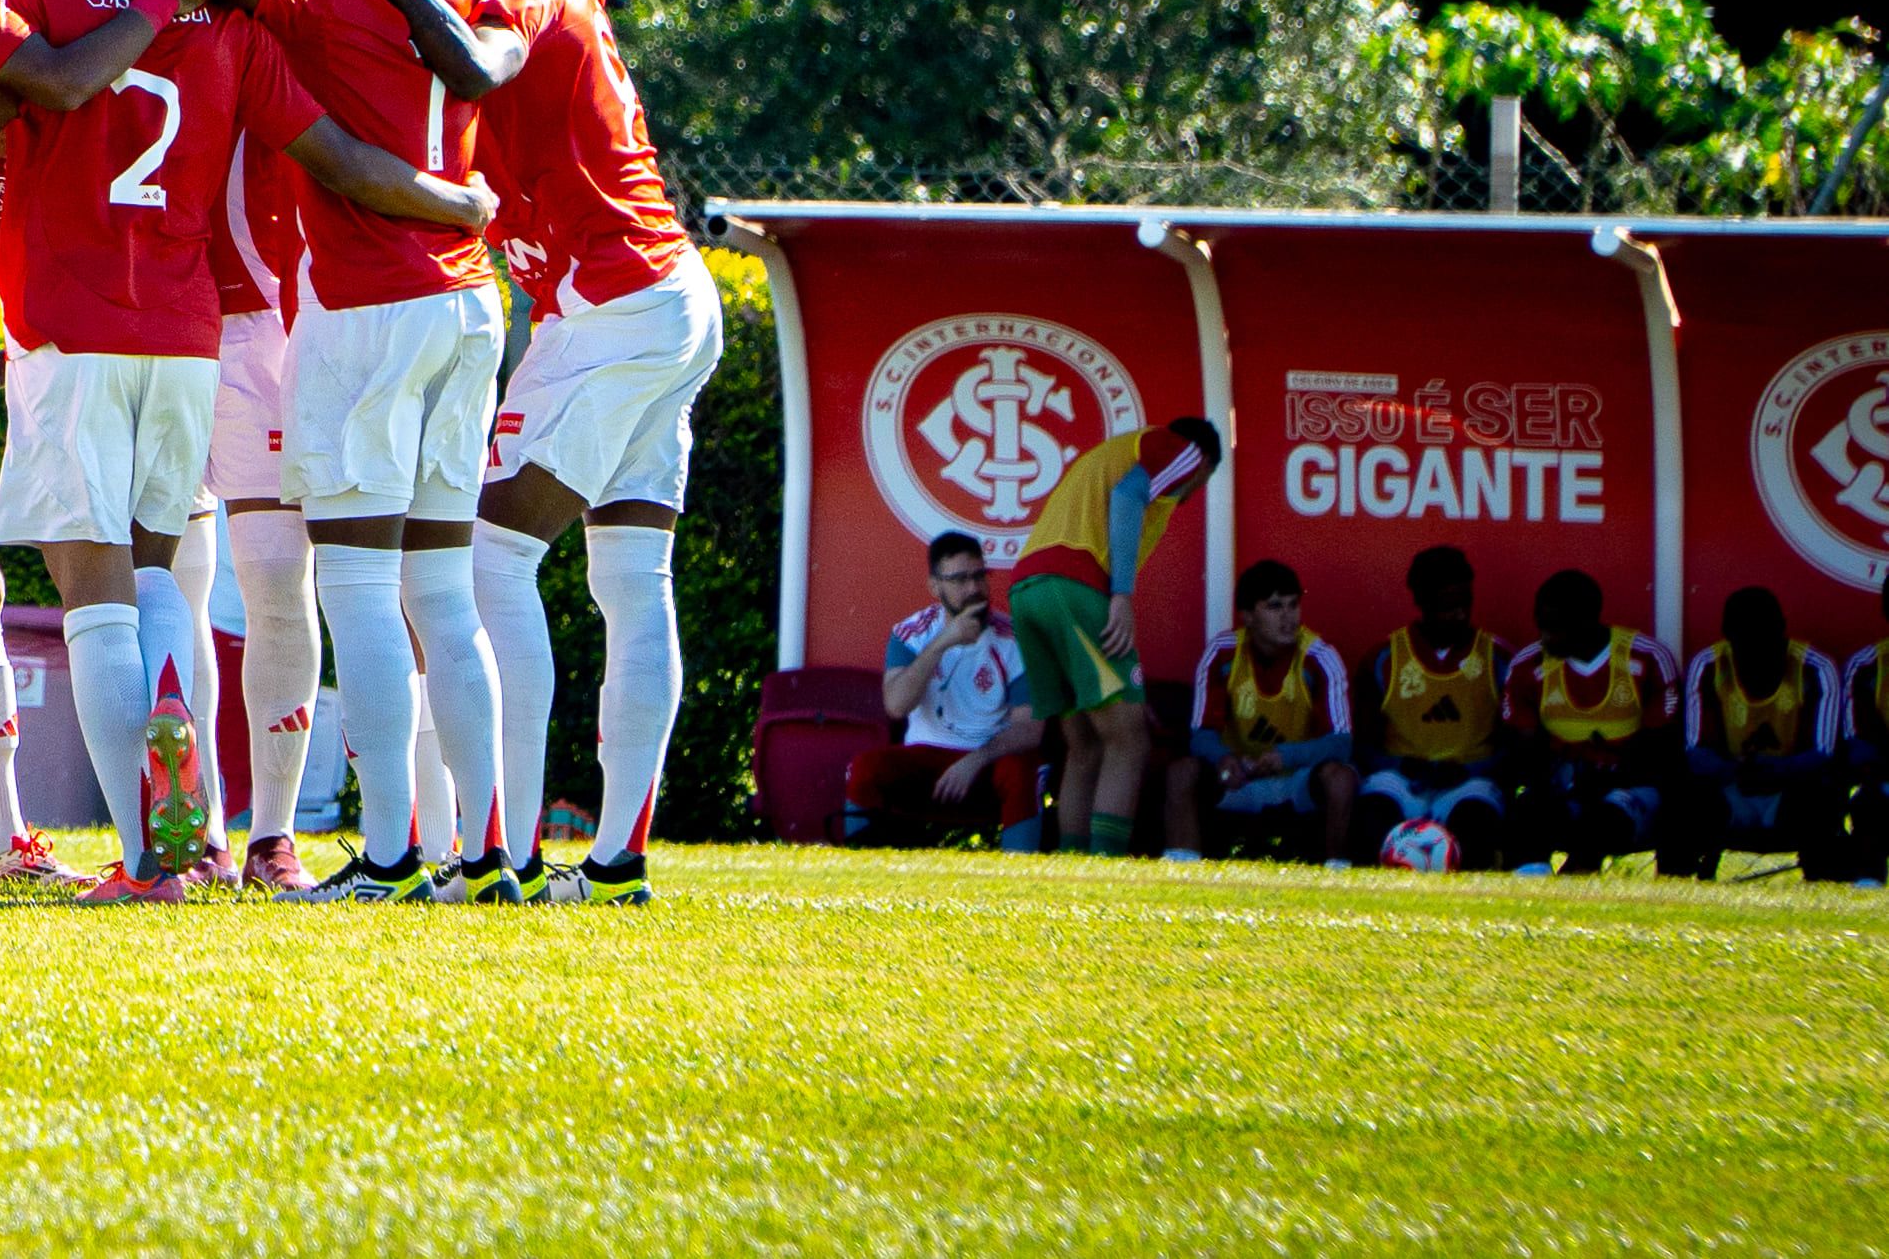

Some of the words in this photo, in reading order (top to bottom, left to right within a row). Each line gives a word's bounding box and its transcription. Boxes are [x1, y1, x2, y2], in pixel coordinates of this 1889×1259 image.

[110, 67, 181, 208] 2
[1285, 392, 1405, 442] ISSO
[1414, 378, 1455, 444] É
[1463, 381, 1604, 448] SER
[1285, 443, 1606, 524] GIGANTE
